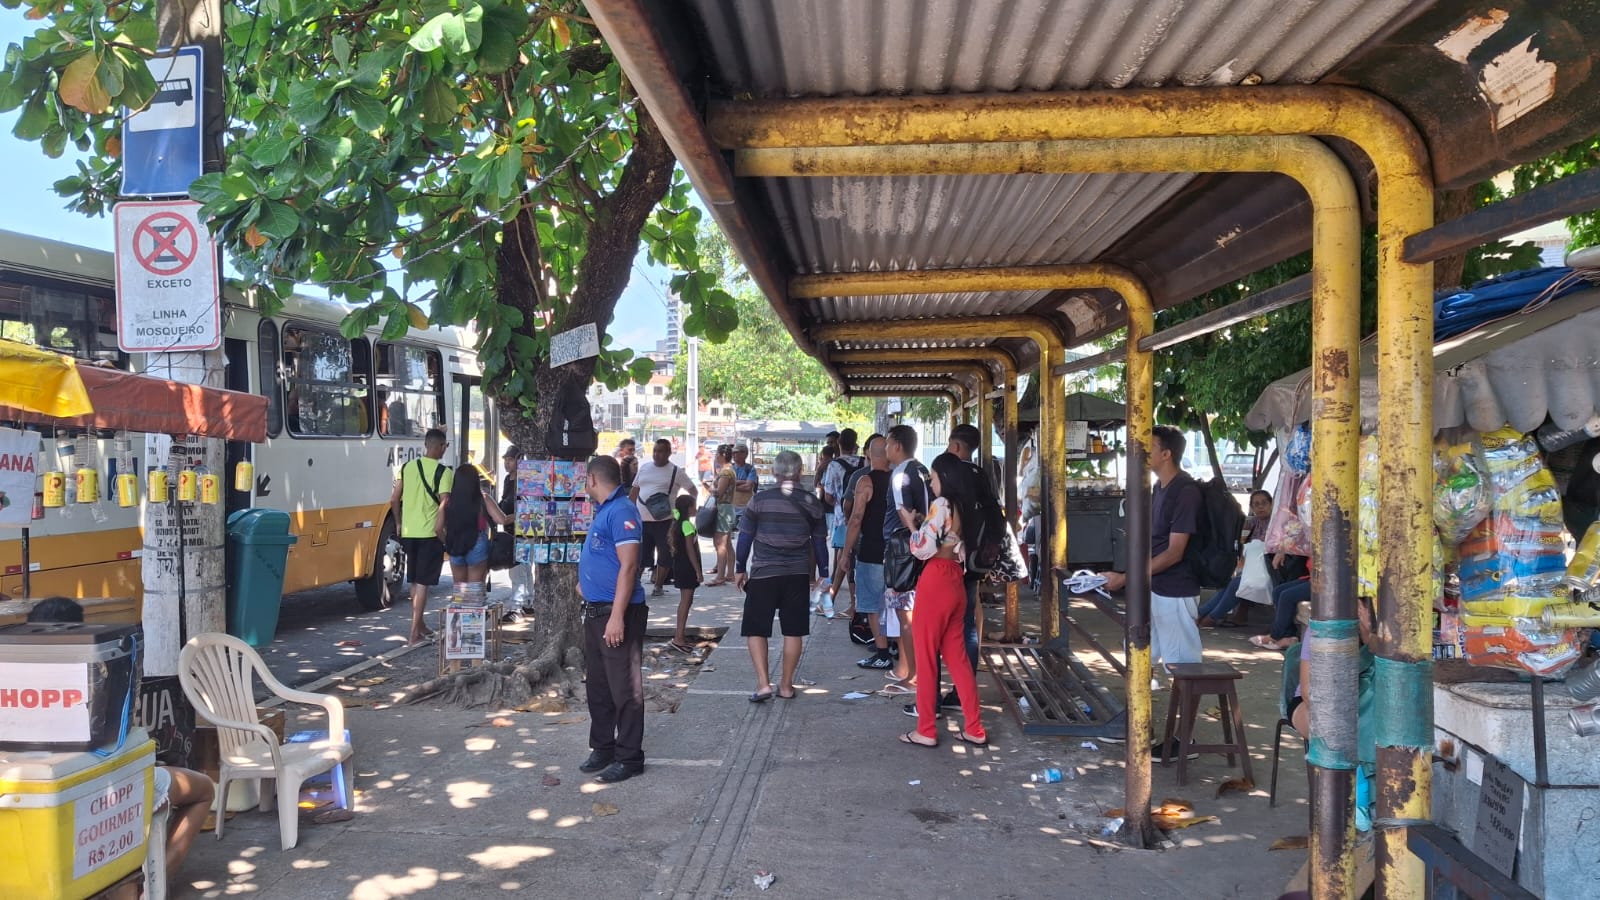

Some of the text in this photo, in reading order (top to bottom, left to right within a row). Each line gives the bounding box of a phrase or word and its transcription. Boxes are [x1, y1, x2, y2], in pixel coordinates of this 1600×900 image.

[147, 278, 192, 289] EXCETO
[152, 309, 187, 320] LINHA
[136, 325, 205, 336] MOSQUEIRO
[0, 688, 83, 709] HOPP
[90, 783, 134, 815] CHOPP
[78, 802, 143, 846] GOURMET
[88, 830, 134, 867] R$ 2,00
